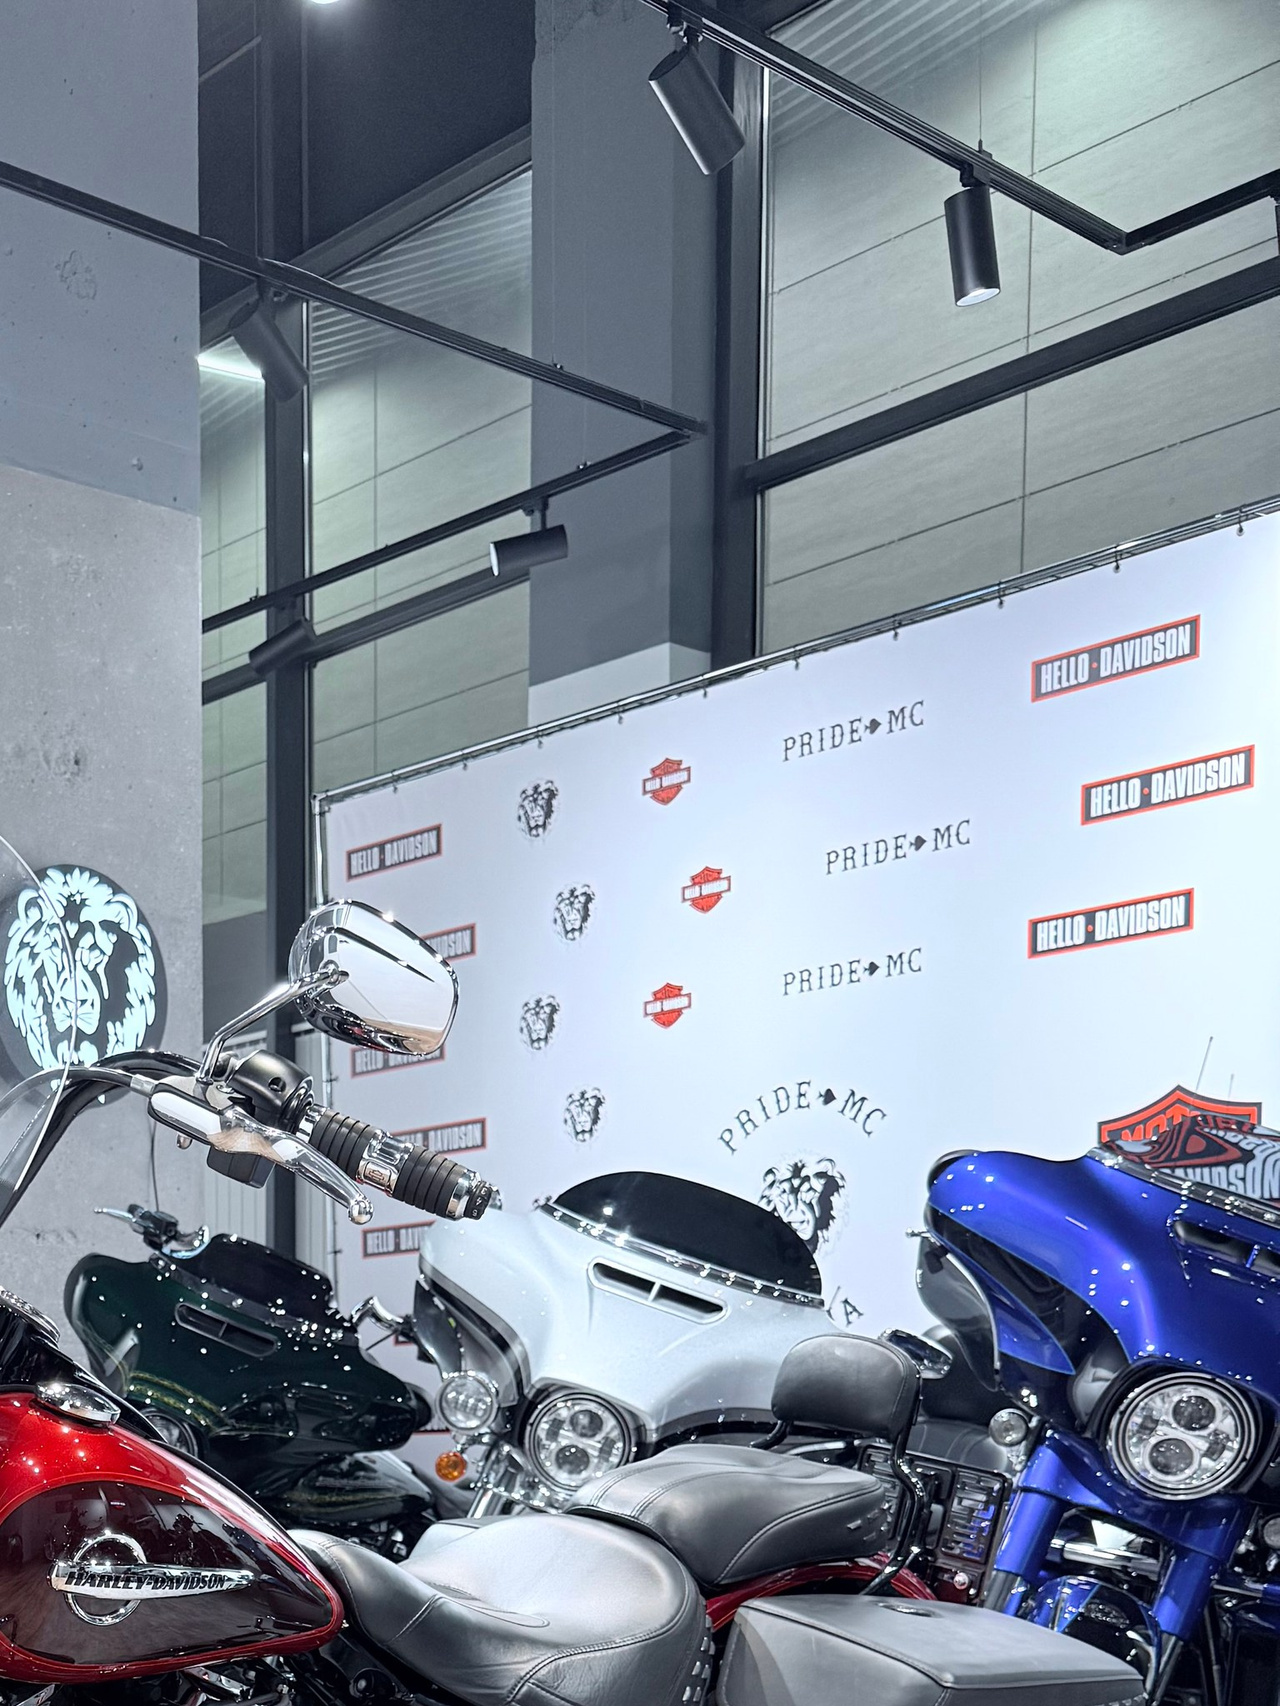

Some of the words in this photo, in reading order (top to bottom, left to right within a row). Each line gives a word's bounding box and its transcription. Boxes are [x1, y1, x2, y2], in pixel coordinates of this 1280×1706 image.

[1041, 653, 1089, 694] HELLO
[1100, 624, 1191, 678] DAVIDSON
[782, 716, 862, 762] PRIDE
[886, 700, 924, 734] MC
[1090, 777, 1141, 818] HELLO
[1151, 753, 1245, 805] DAVIDSON
[350, 846, 380, 876] HELLO
[384, 829, 438, 867] DAVIDSON
[826, 833, 907, 875] PRIDE
[932, 818, 970, 852] MC
[1036, 915, 1086, 952] HELLO
[1094, 895, 1185, 942] DAVIDSON
[783, 959, 861, 996] PRIDE
[885, 947, 922, 978] MC
[718, 1080, 811, 1155] PRIDE
[838, 1089, 887, 1137] MC
[65, 1571, 227, 1590] HARLEY-DAVIDSON
